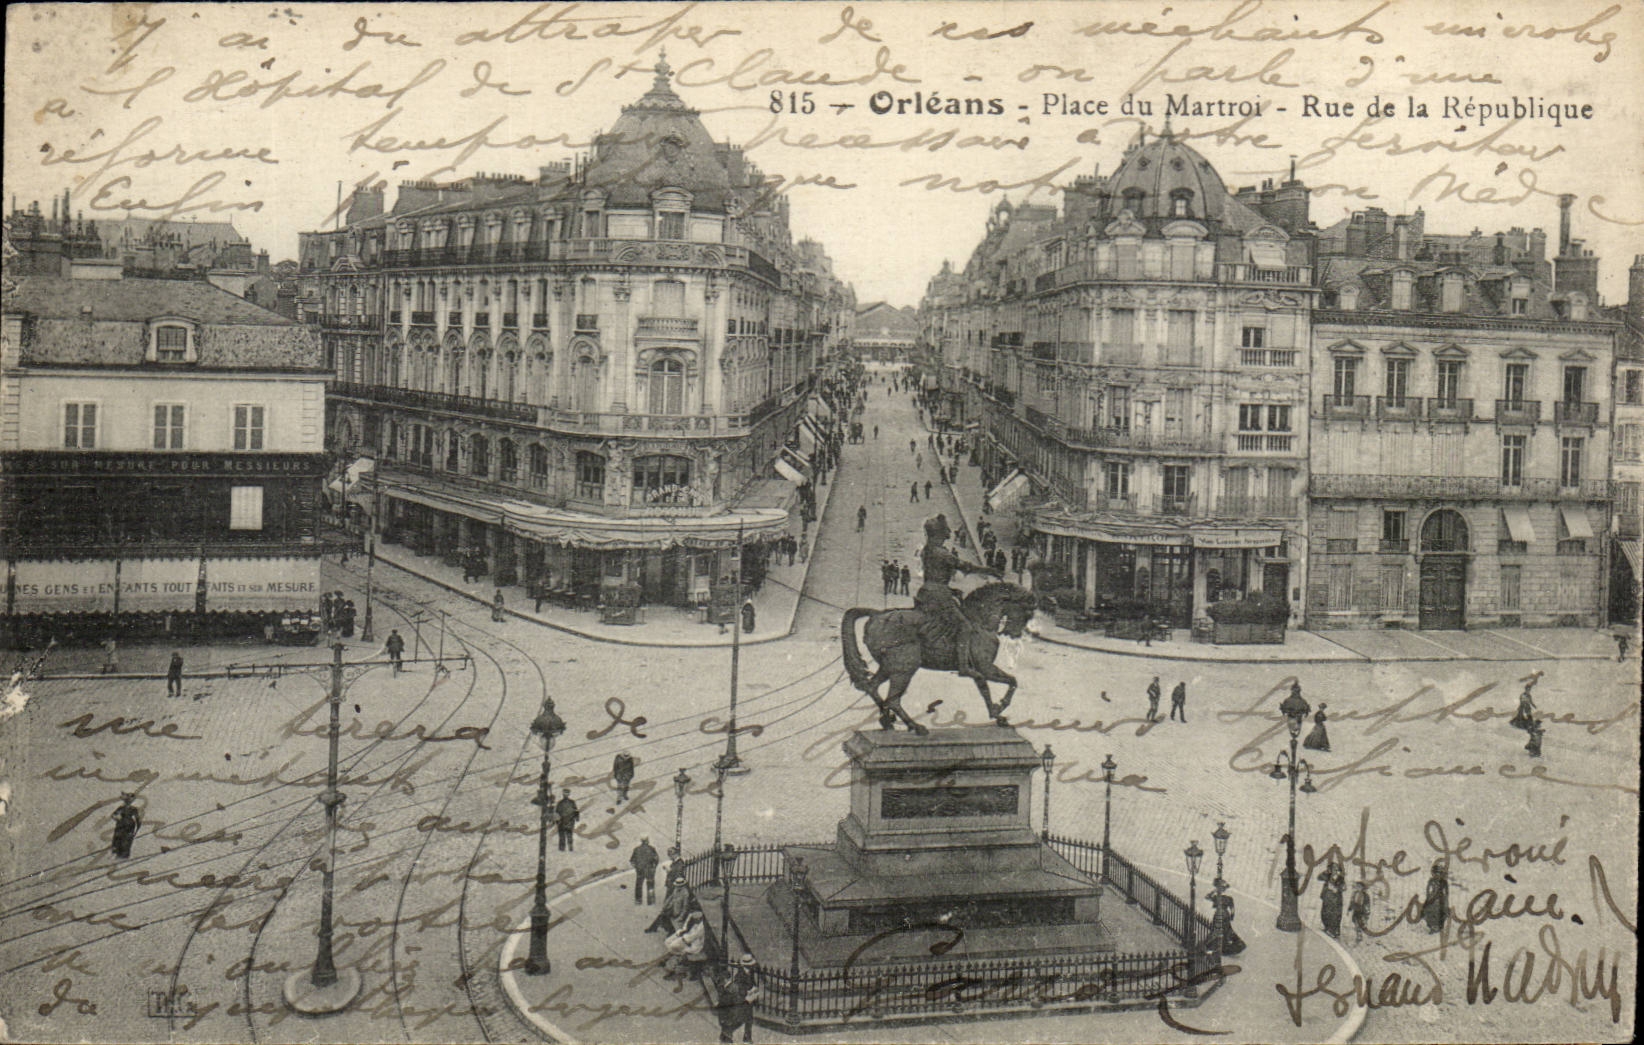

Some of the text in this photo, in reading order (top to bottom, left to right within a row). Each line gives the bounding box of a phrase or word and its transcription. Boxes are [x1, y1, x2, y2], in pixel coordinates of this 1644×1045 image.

[818, 6, 882, 44] de
[460, 61, 533, 97] de
[171, 459, 211, 472] POUR
[223, 459, 312, 472] MESSIEURS
[44, 583, 80, 596] GENS
[98, 582, 158, 595] ENFANTS
[162, 582, 192, 593] TOUT
[266, 581, 316, 594] MESURE
